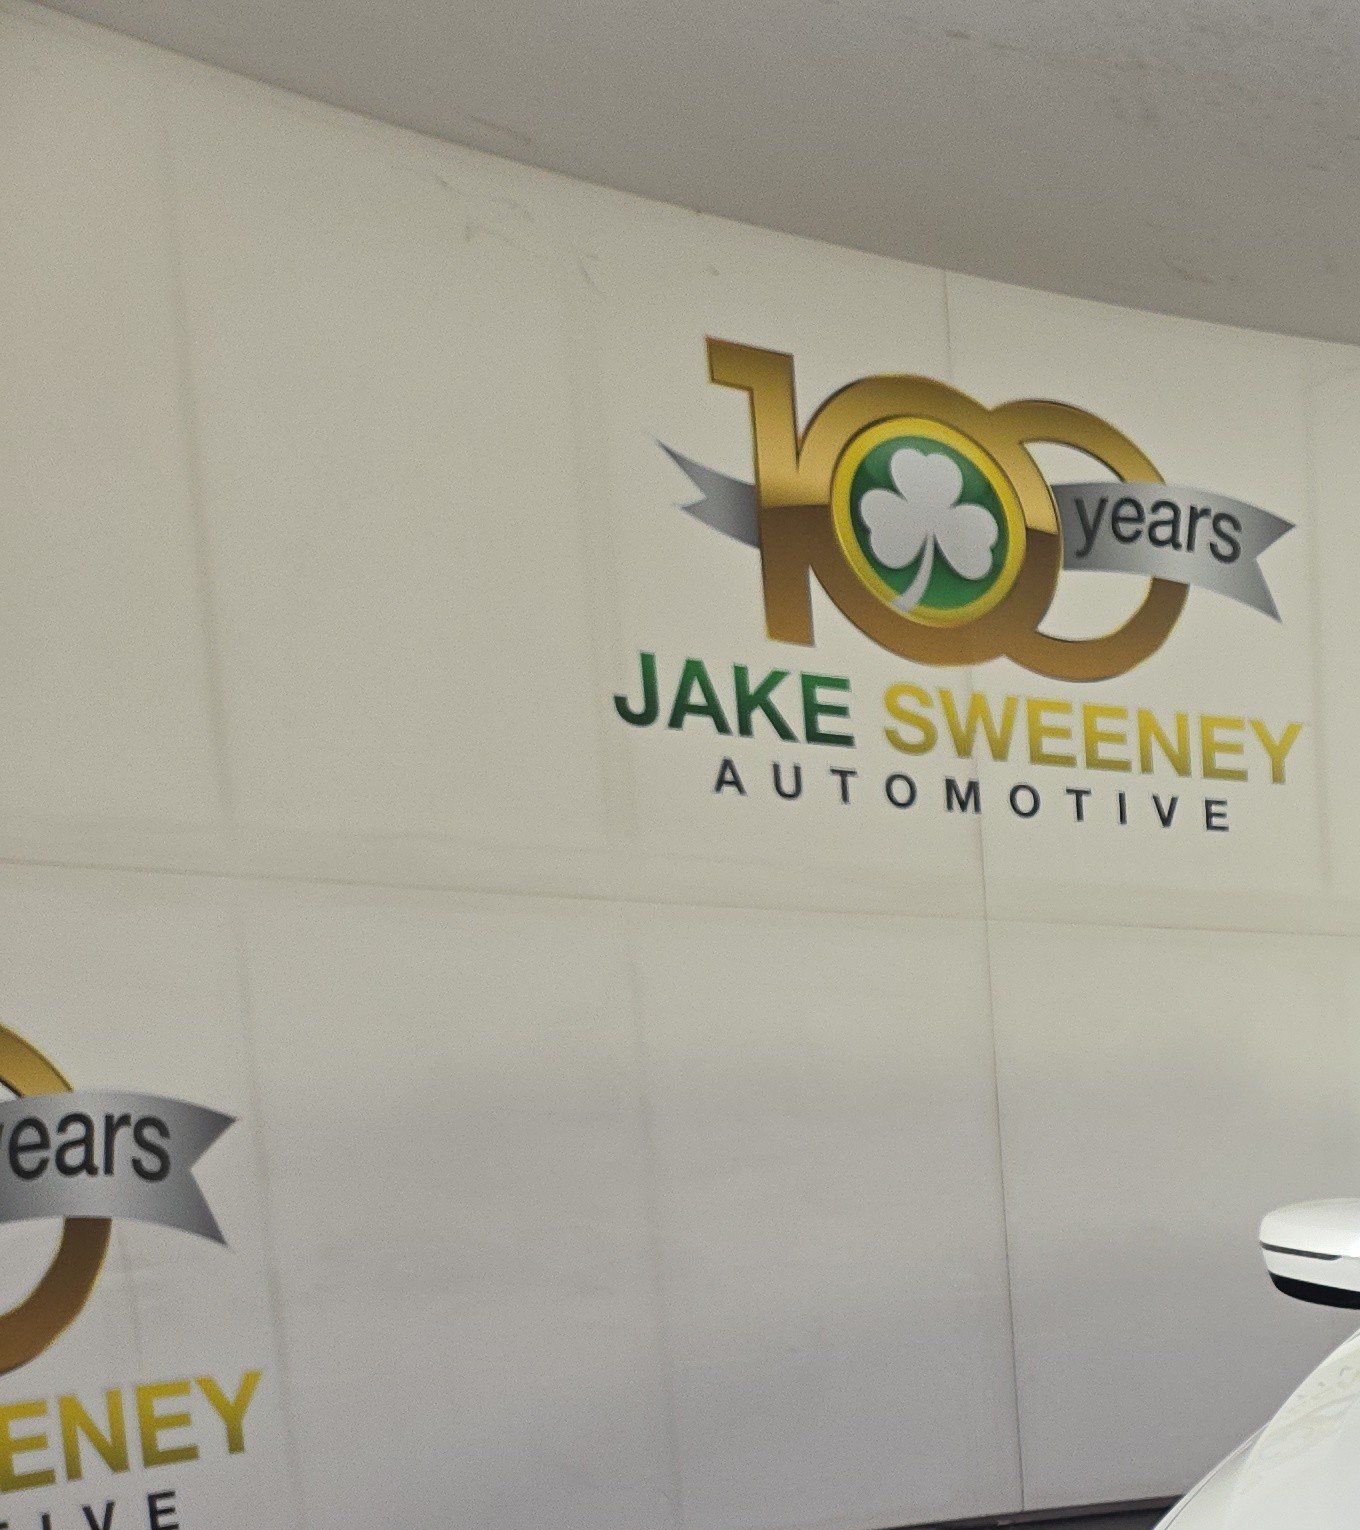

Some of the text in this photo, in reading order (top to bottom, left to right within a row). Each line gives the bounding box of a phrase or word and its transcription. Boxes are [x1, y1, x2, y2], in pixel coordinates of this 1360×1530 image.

[1074, 497, 1242, 565] years
[613, 651, 1304, 785] JAKE SWEENEY
[715, 757, 1229, 832] AUTOMOTIVE
[0, 1111, 171, 1182] ears
